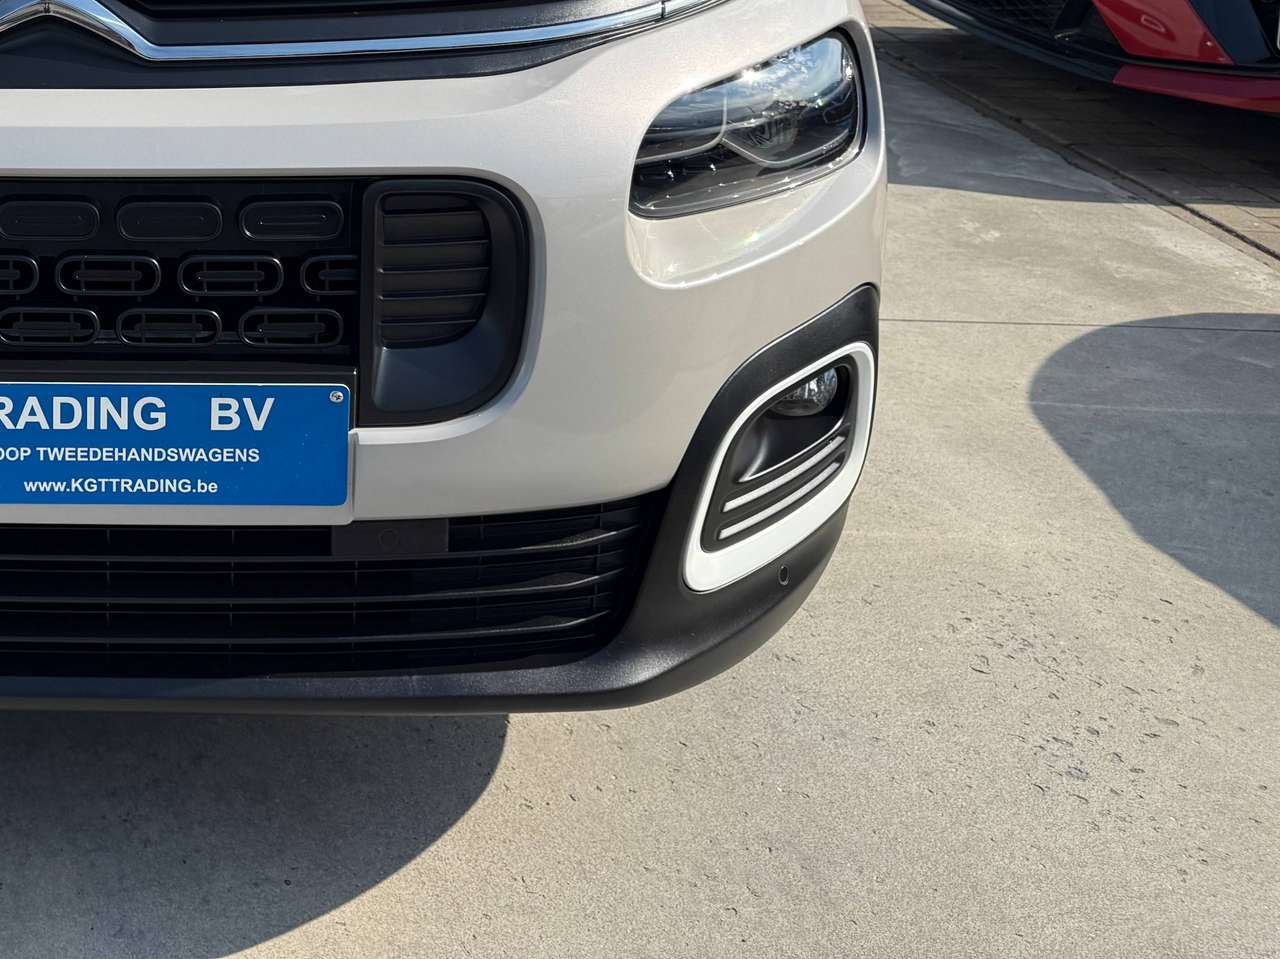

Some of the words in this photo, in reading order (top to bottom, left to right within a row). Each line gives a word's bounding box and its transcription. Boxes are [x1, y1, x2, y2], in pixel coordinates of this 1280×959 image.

[210, 397, 275, 431] BV
[37, 447, 260, 463] TWEEDEHANDSWAGENS
[24, 478, 218, 493] www.KGTTRADING.be
